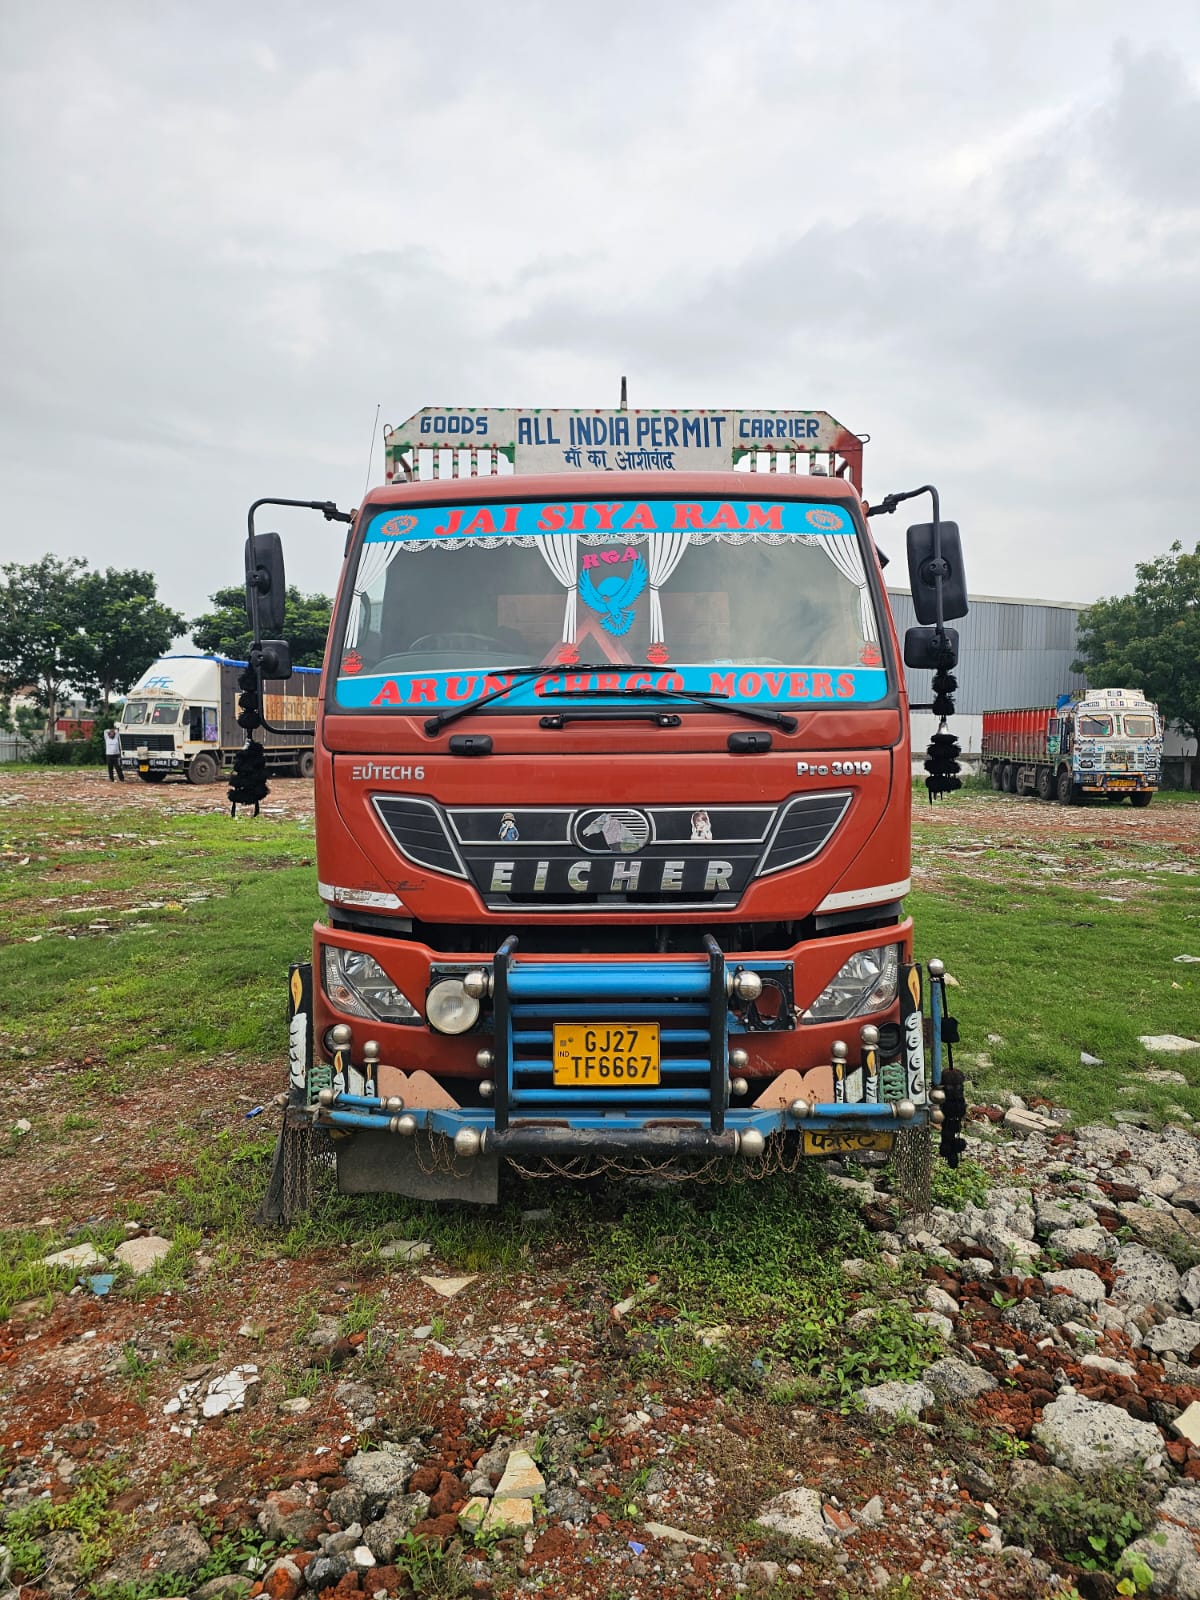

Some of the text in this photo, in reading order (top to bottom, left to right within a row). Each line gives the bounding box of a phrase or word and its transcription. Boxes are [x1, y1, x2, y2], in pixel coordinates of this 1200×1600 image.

[420, 415, 488, 435] GOODS
[518, 416, 726, 448] ALL INDIA PERMIT
[738, 418, 820, 438] CARRIER
[586, 450, 608, 468] का
[434, 507, 521, 535] JAI
[537, 503, 658, 531] SIYA
[671, 503, 784, 530] RAM
[370, 672, 517, 705] ARUN
[708, 672, 855, 698] MOVERS
[797, 761, 872, 776] Pro 3019
[490, 860, 734, 892] EICHER
[584, 1030, 639, 1053] GJ27
[571, 1055, 652, 1079] TF6667
